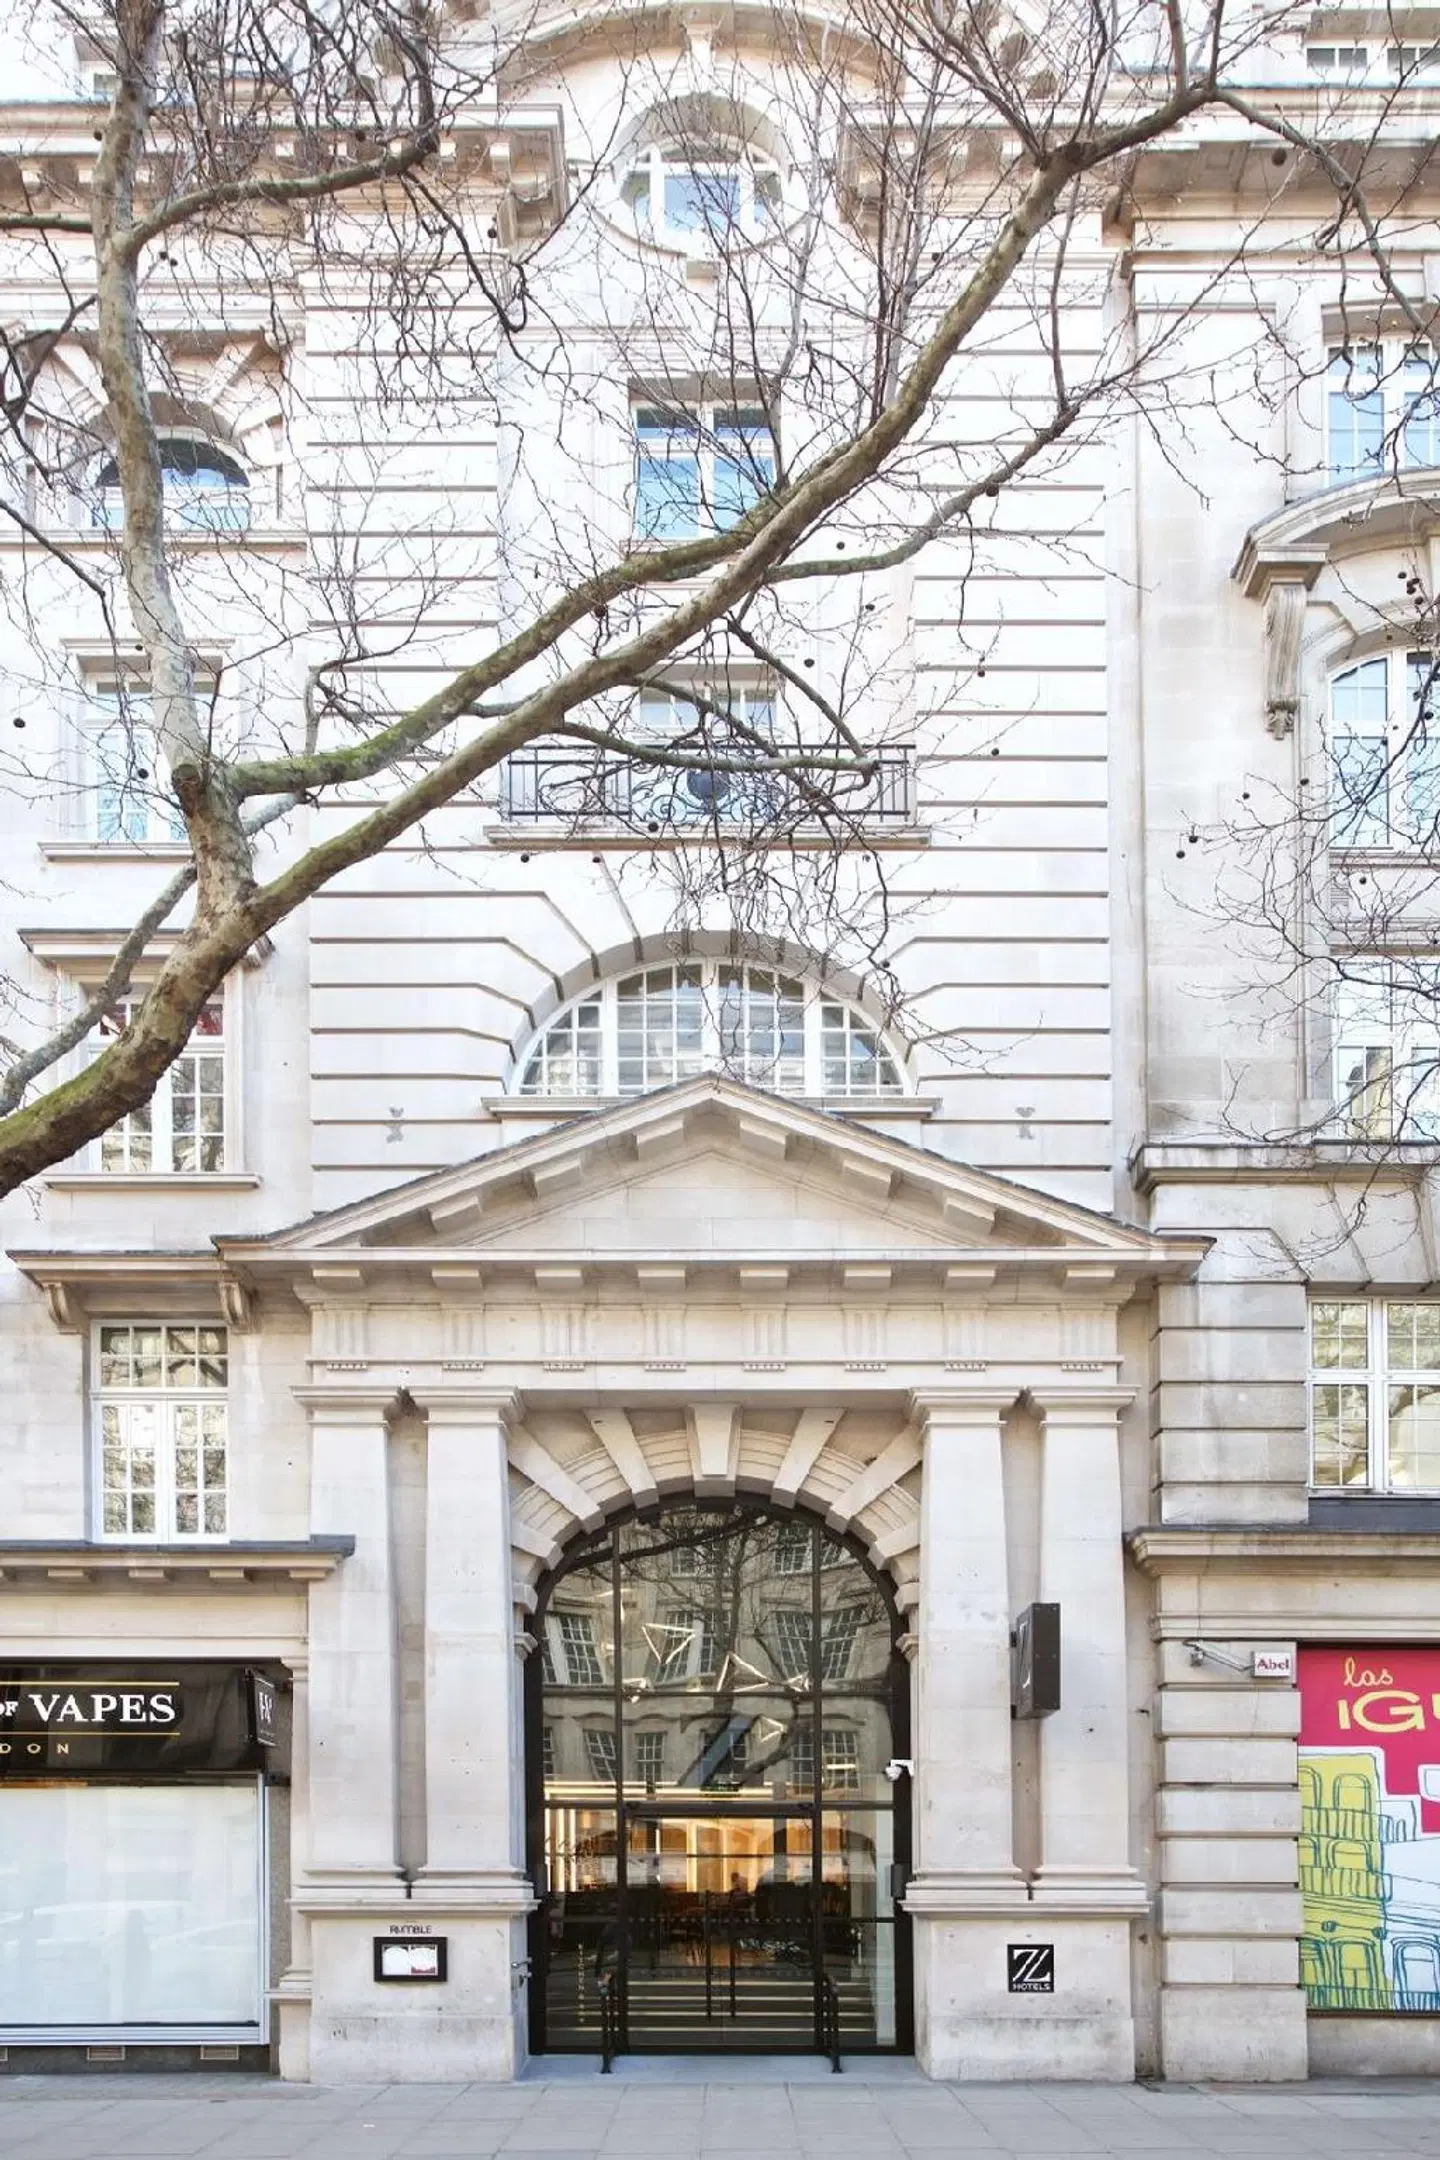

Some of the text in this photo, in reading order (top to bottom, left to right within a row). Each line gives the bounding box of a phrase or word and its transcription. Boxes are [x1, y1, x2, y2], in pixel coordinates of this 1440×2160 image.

[1257, 1658, 1289, 1670] Abel
[1343, 1656, 1394, 1687] las
[28, 1694, 176, 1722] VAPES
[1012, 1948, 1051, 1982] Z
[1012, 1982, 1051, 1991] HOTELS
